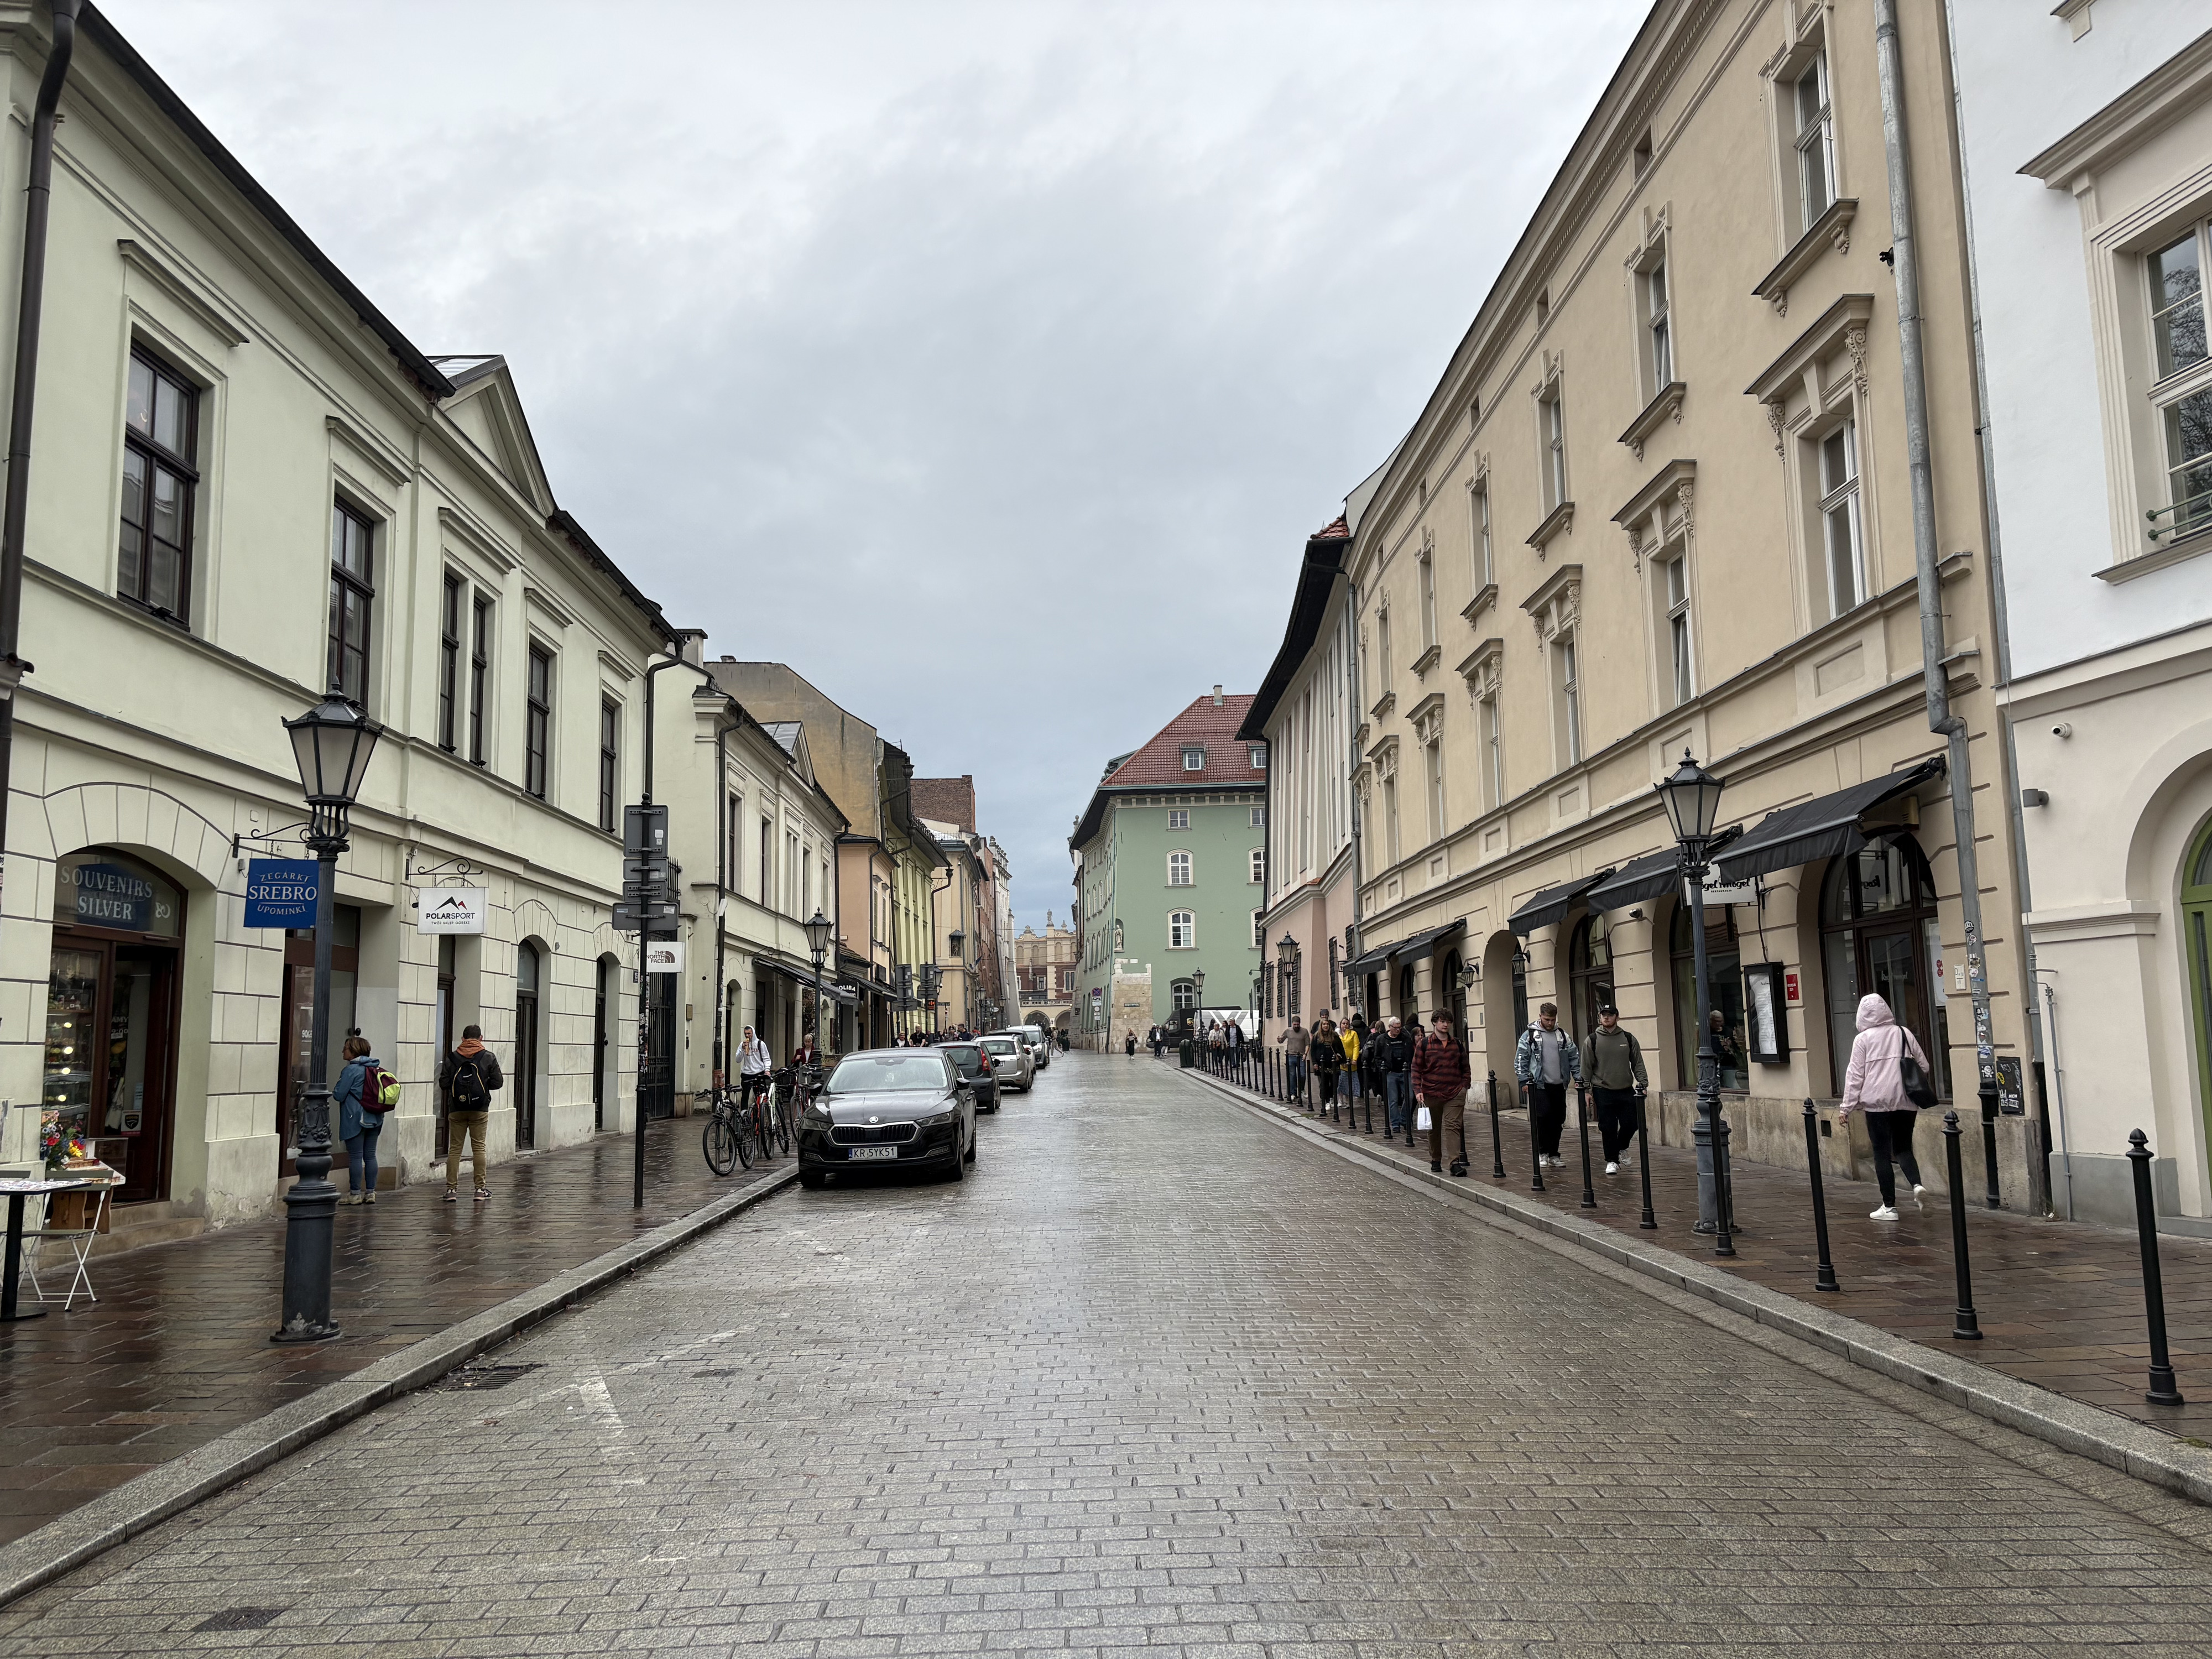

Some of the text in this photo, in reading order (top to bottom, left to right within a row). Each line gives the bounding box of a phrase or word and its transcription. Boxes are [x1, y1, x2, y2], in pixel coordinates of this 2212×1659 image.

[60, 865, 153, 898] SOUVENIRS
[258, 872, 311, 882] ZEGARKI
[248, 885, 317, 901] SREBRO
[78, 896, 133, 920] SILVER
[257, 904, 307, 915] UPOMINKI
[854, 1147, 894, 1157] KR 5YK51
